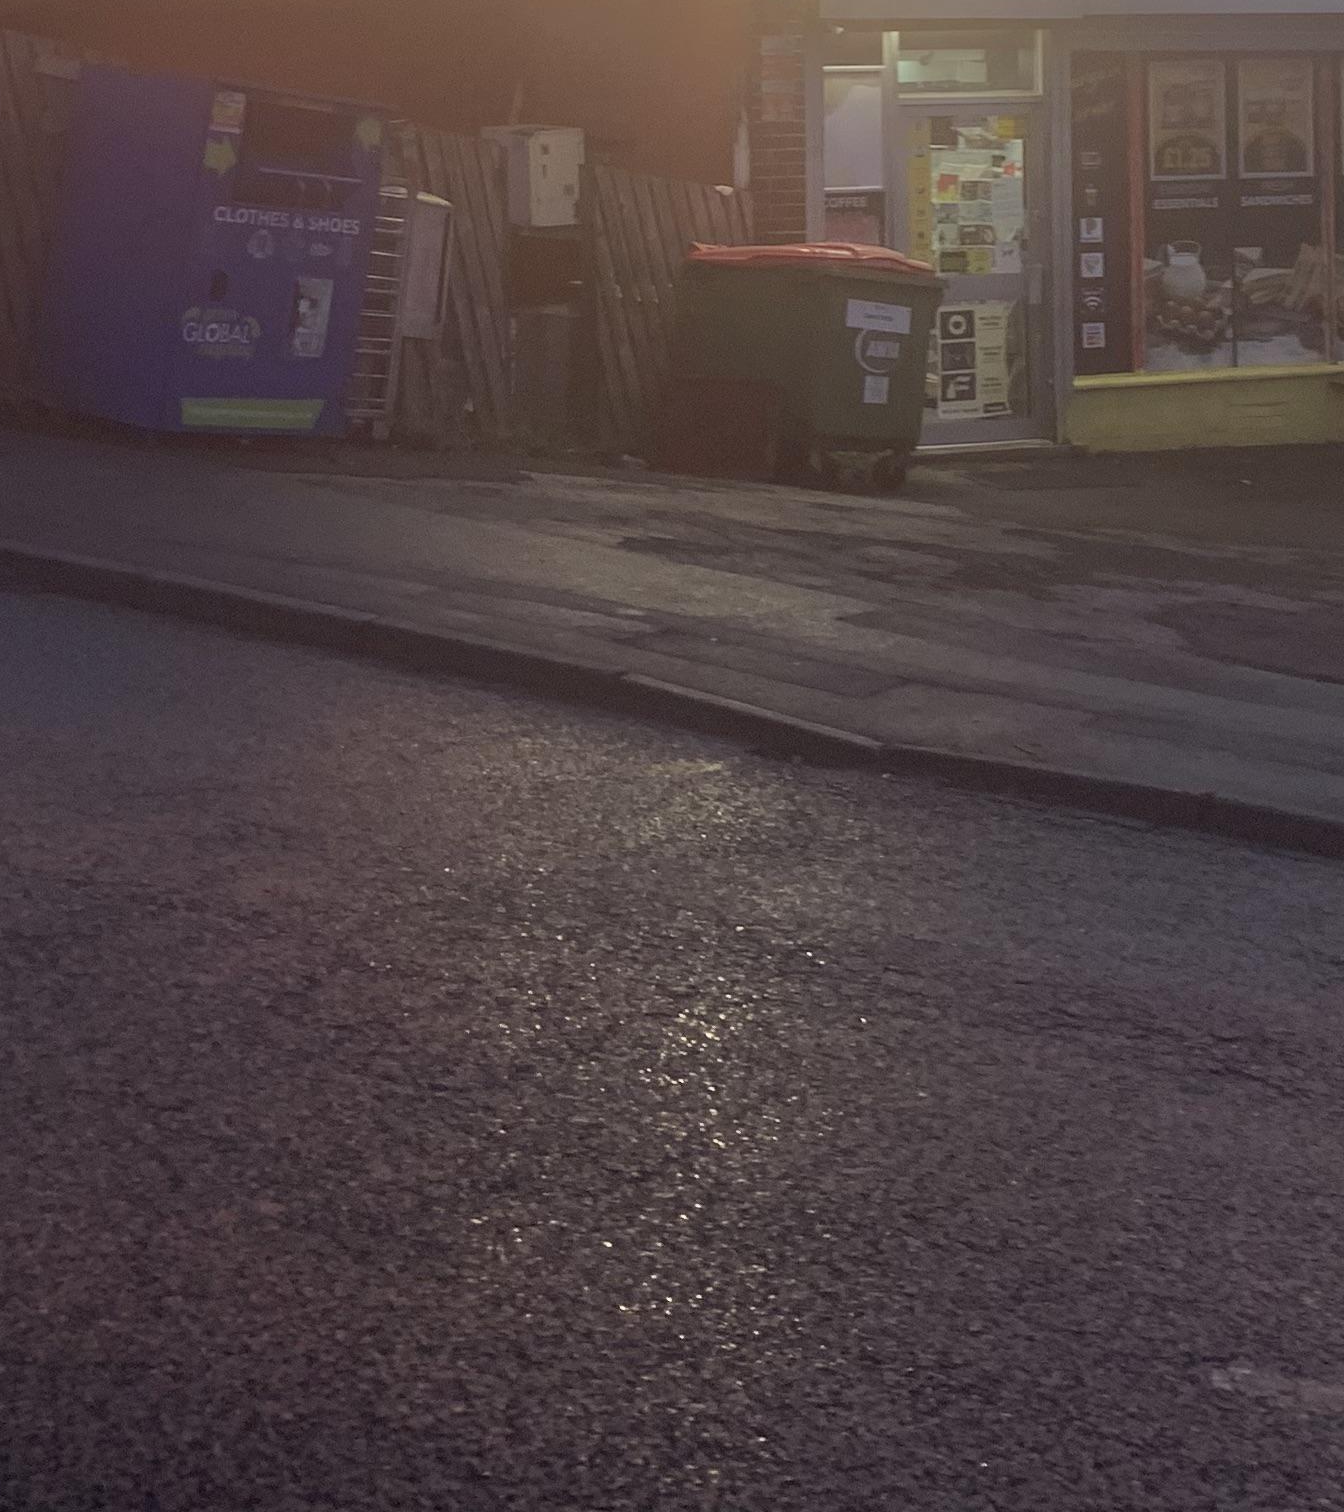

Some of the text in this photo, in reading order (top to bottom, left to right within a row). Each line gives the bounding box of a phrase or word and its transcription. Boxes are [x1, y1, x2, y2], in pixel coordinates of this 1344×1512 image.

[213, 206, 360, 235] CLOTHES & SHOES
[182, 321, 251, 344] GLOBAL
